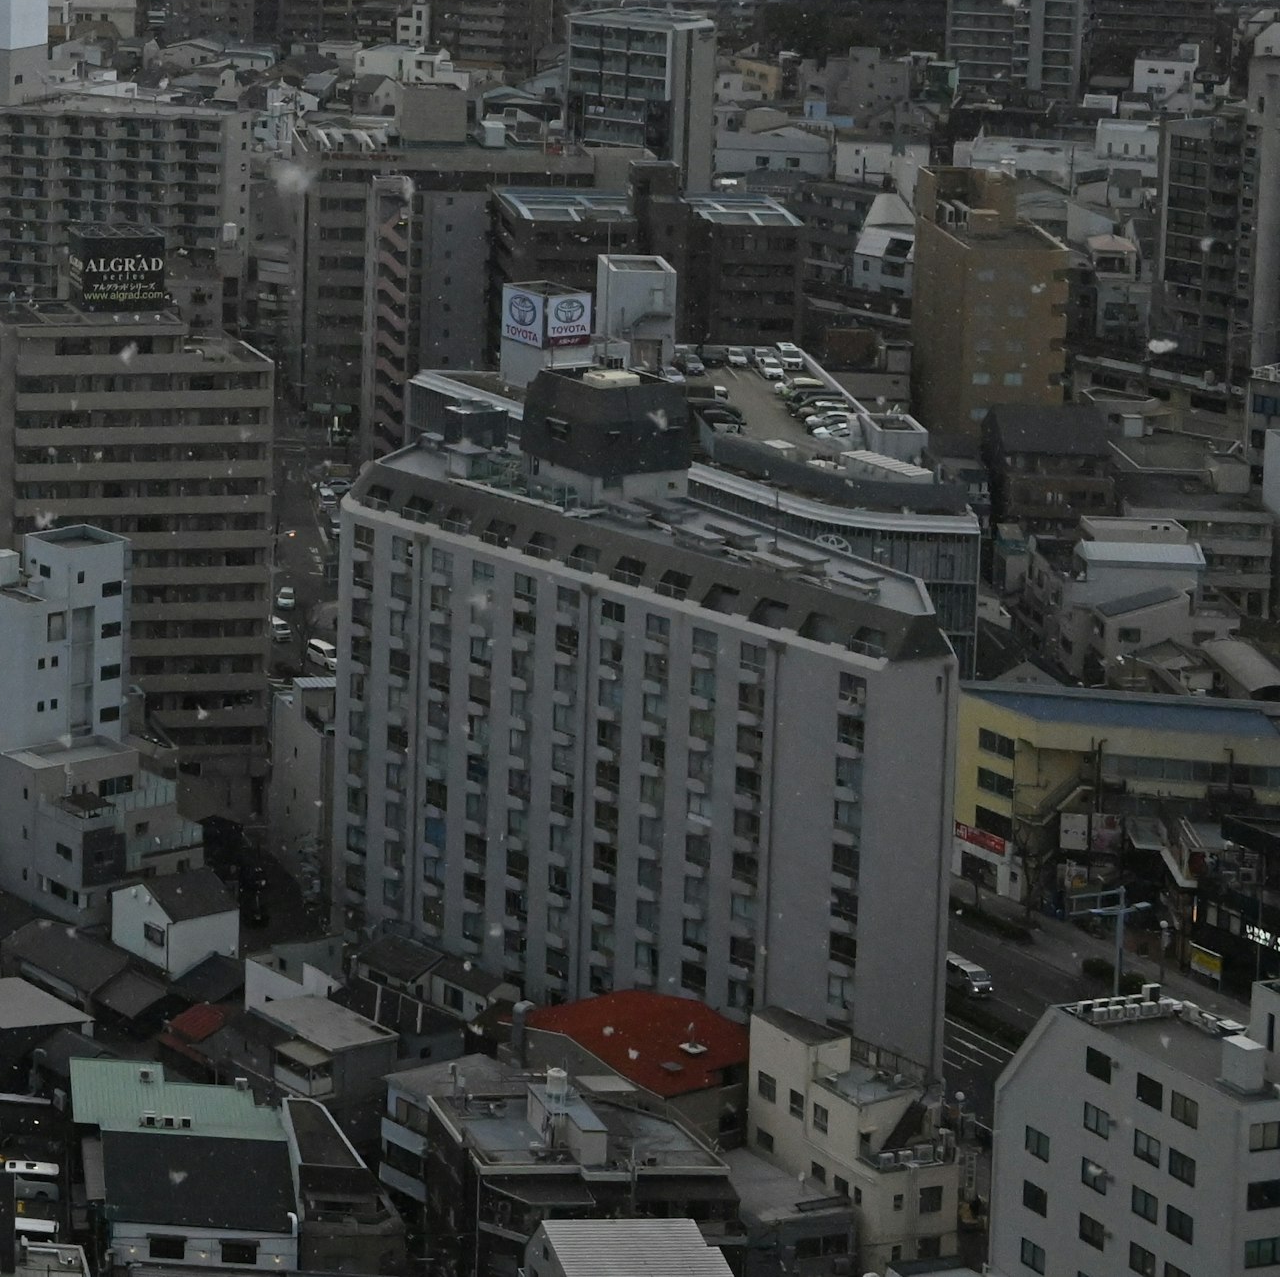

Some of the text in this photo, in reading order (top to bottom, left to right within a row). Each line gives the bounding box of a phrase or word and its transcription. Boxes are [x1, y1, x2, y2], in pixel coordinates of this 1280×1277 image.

[85, 257, 164, 273] ALGRAD
[102, 272, 145, 281] series
[84, 290, 164, 302] www.algrad.com
[505, 324, 538, 342] TOYOTA
[551, 324, 587, 335] TOYOTA
